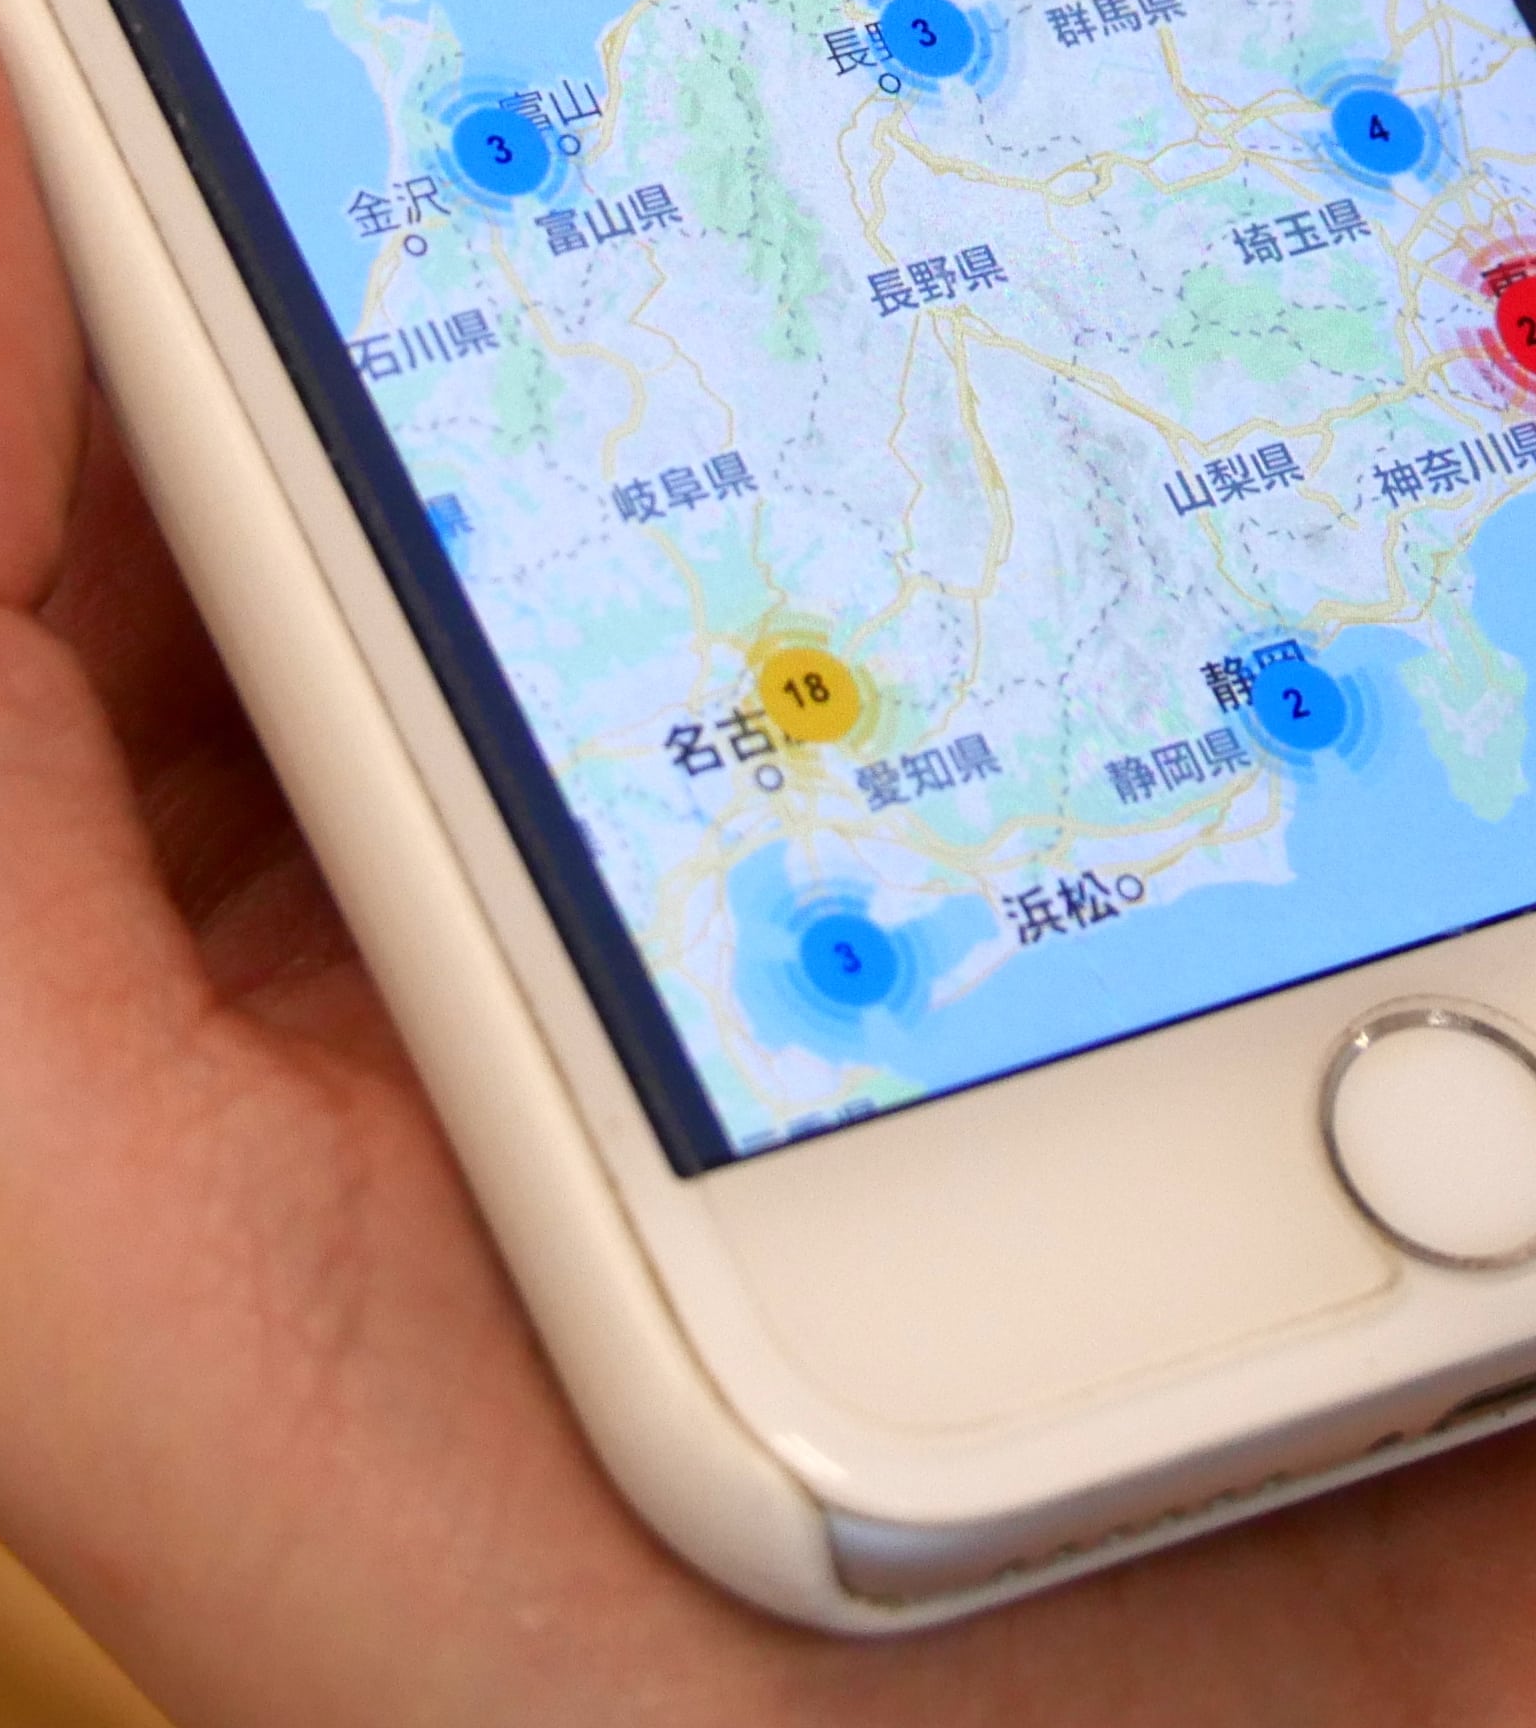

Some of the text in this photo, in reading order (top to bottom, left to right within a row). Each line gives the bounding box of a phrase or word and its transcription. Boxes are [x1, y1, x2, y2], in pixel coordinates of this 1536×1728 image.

[911, 17, 938, 48] 3
[486, 134, 513, 165] 3
[1366, 114, 1391, 146] 4
[347, 174, 452, 238] 金沢
[534, 182, 684, 259] 富山県
[1232, 197, 1372, 270] 埼玉県
[866, 243, 1009, 318] 長野県
[347, 308, 501, 382] 石川県
[610, 449, 761, 526] 岐阜県
[1163, 441, 1306, 518] 山梨県
[783, 671, 831, 709] 18
[1282, 687, 1312, 720] 2
[664, 706, 802, 777] 名古
[854, 732, 1004, 816] 愛知県
[1106, 726, 1253, 807] 静岡県
[1005, 870, 1121, 947] 浜松
[833, 940, 863, 975] 3
